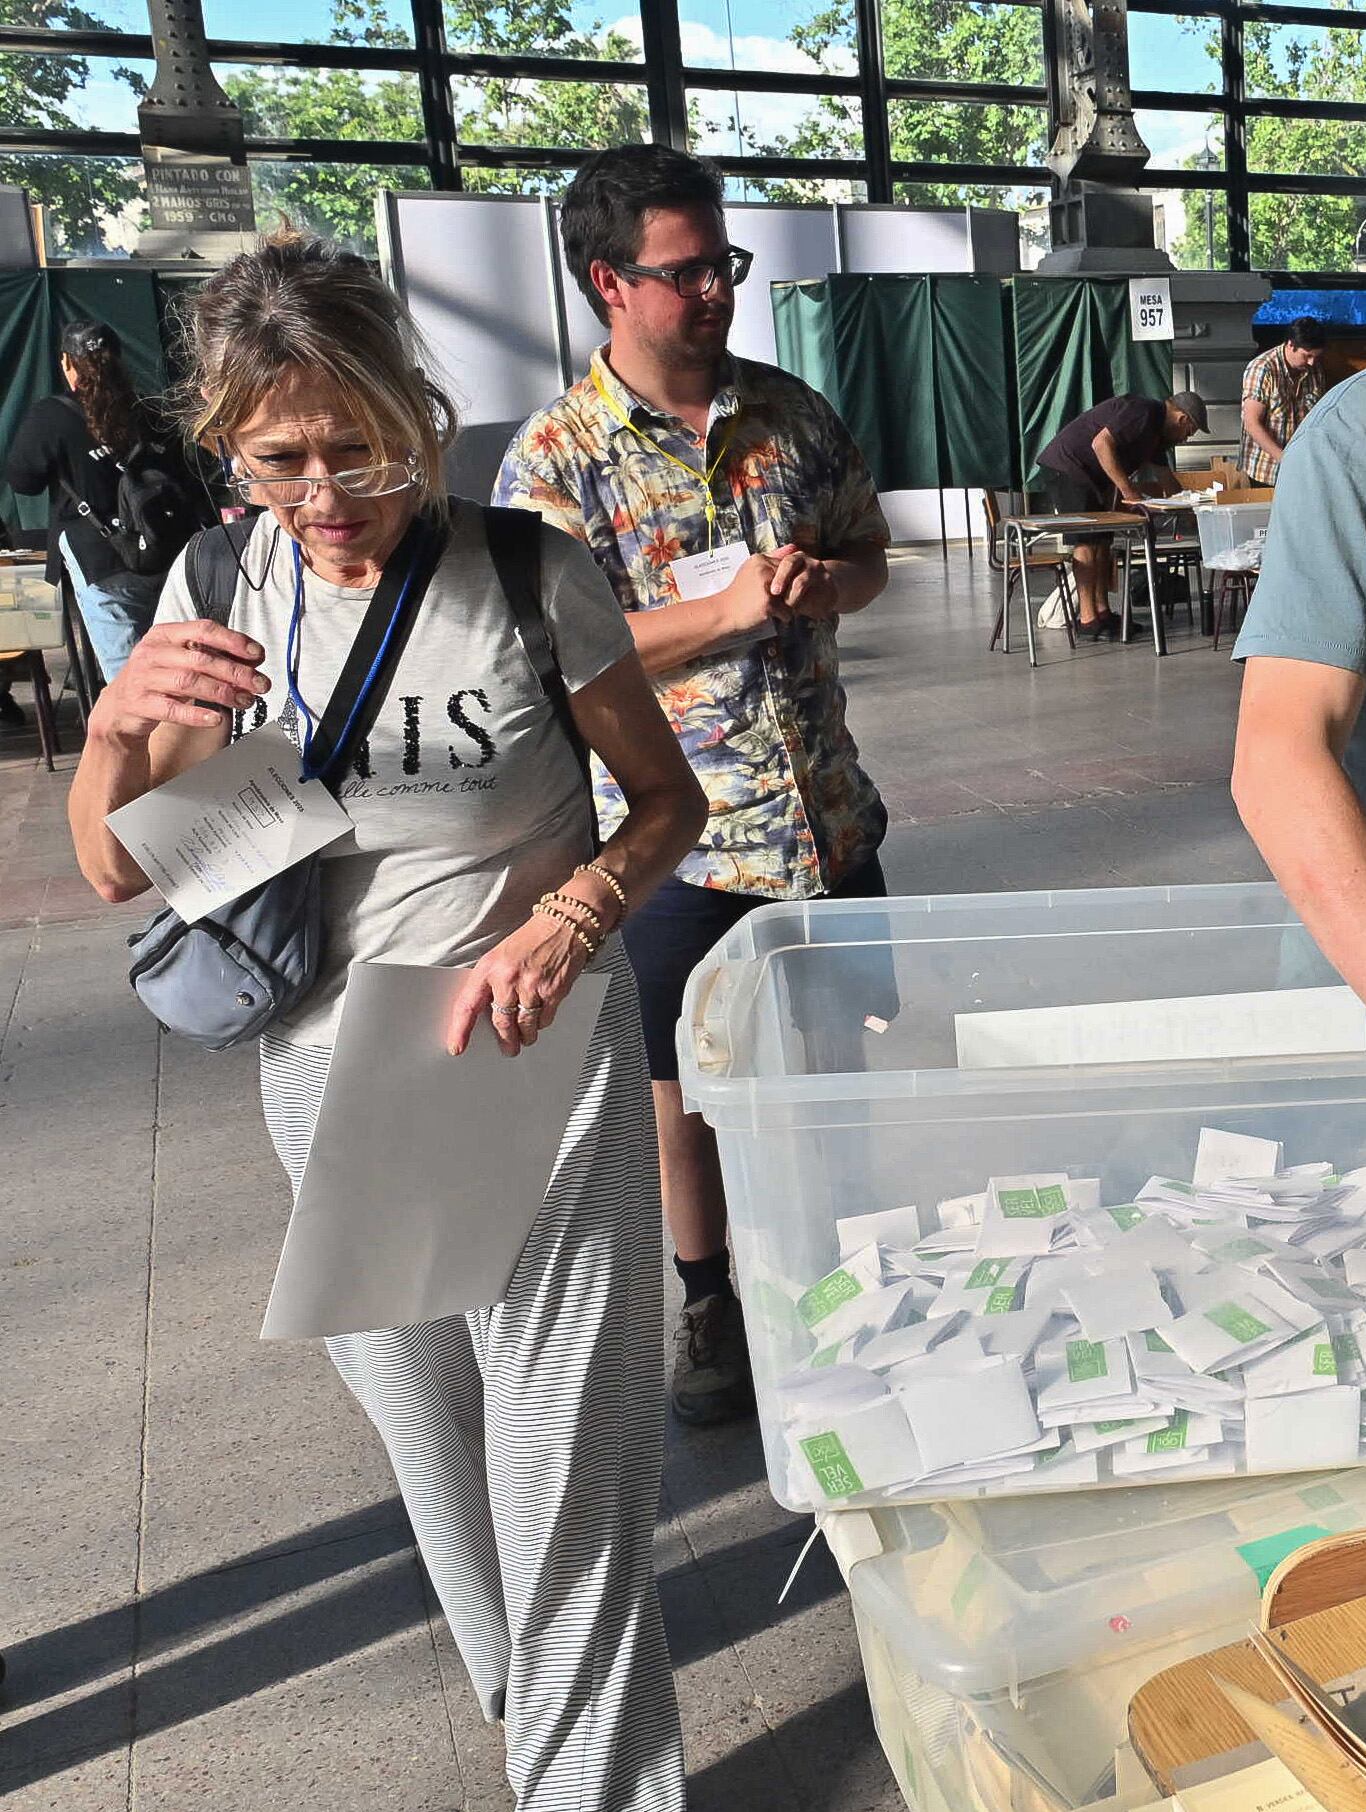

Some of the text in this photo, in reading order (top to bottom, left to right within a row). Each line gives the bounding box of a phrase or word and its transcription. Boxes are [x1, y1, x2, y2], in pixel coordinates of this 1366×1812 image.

[1140, 295, 1162, 305] MESA
[1140, 309, 1163, 327] 957
[377, 782, 454, 796] comme
[460, 776, 498, 794] tout
[818, 1460, 846, 1482] VEL
[824, 1473, 852, 1495] SER
